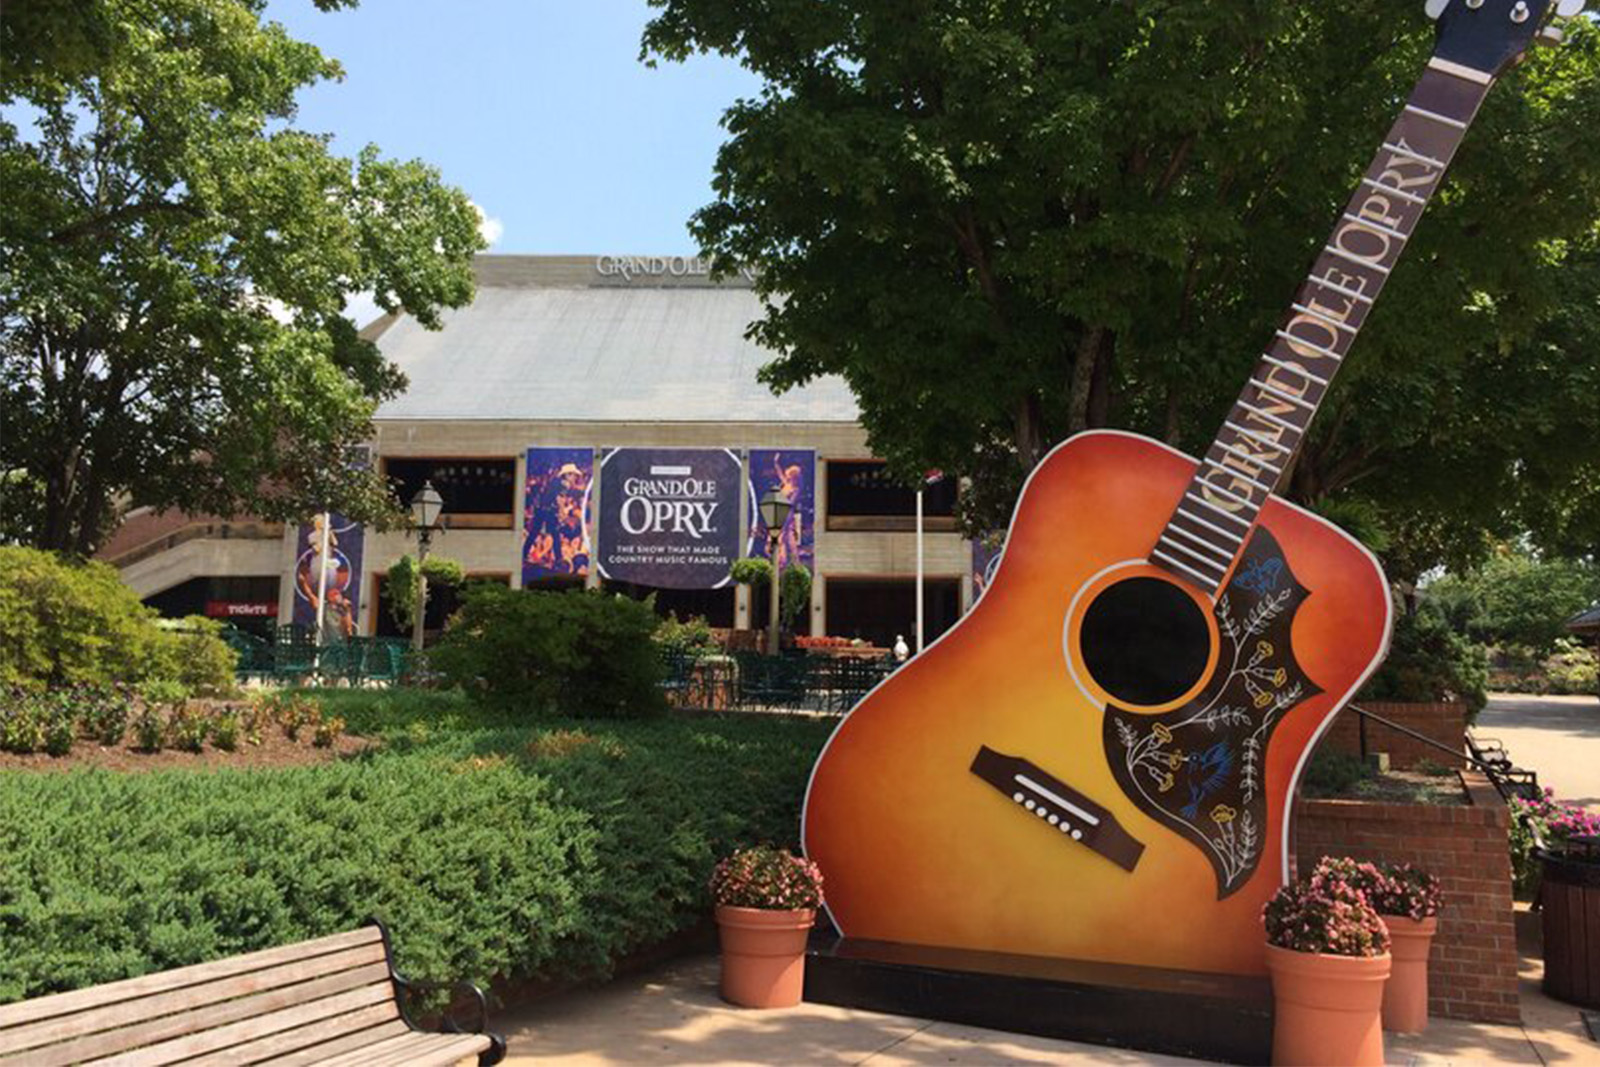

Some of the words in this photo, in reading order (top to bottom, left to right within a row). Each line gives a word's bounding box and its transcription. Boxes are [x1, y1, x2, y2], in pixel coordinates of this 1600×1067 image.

[596, 256, 666, 281] GRAND
[669, 256, 707, 276] OLE
[1201, 359, 1311, 512] GRAND
[1284, 267, 1367, 359] OLE
[1335, 137, 1438, 265] OPRY
[624, 477, 683, 497] GRAND
[683, 477, 716, 497] OLE
[616, 545, 634, 554] THE
[637, 545, 665, 554] SHOW
[667, 545, 691, 554] THAT
[693, 545, 720, 554] MADE
[608, 555, 653, 564] COUNTRY
[655, 555, 686, 564] MUSIC
[688, 555, 728, 565] FAMOUS
